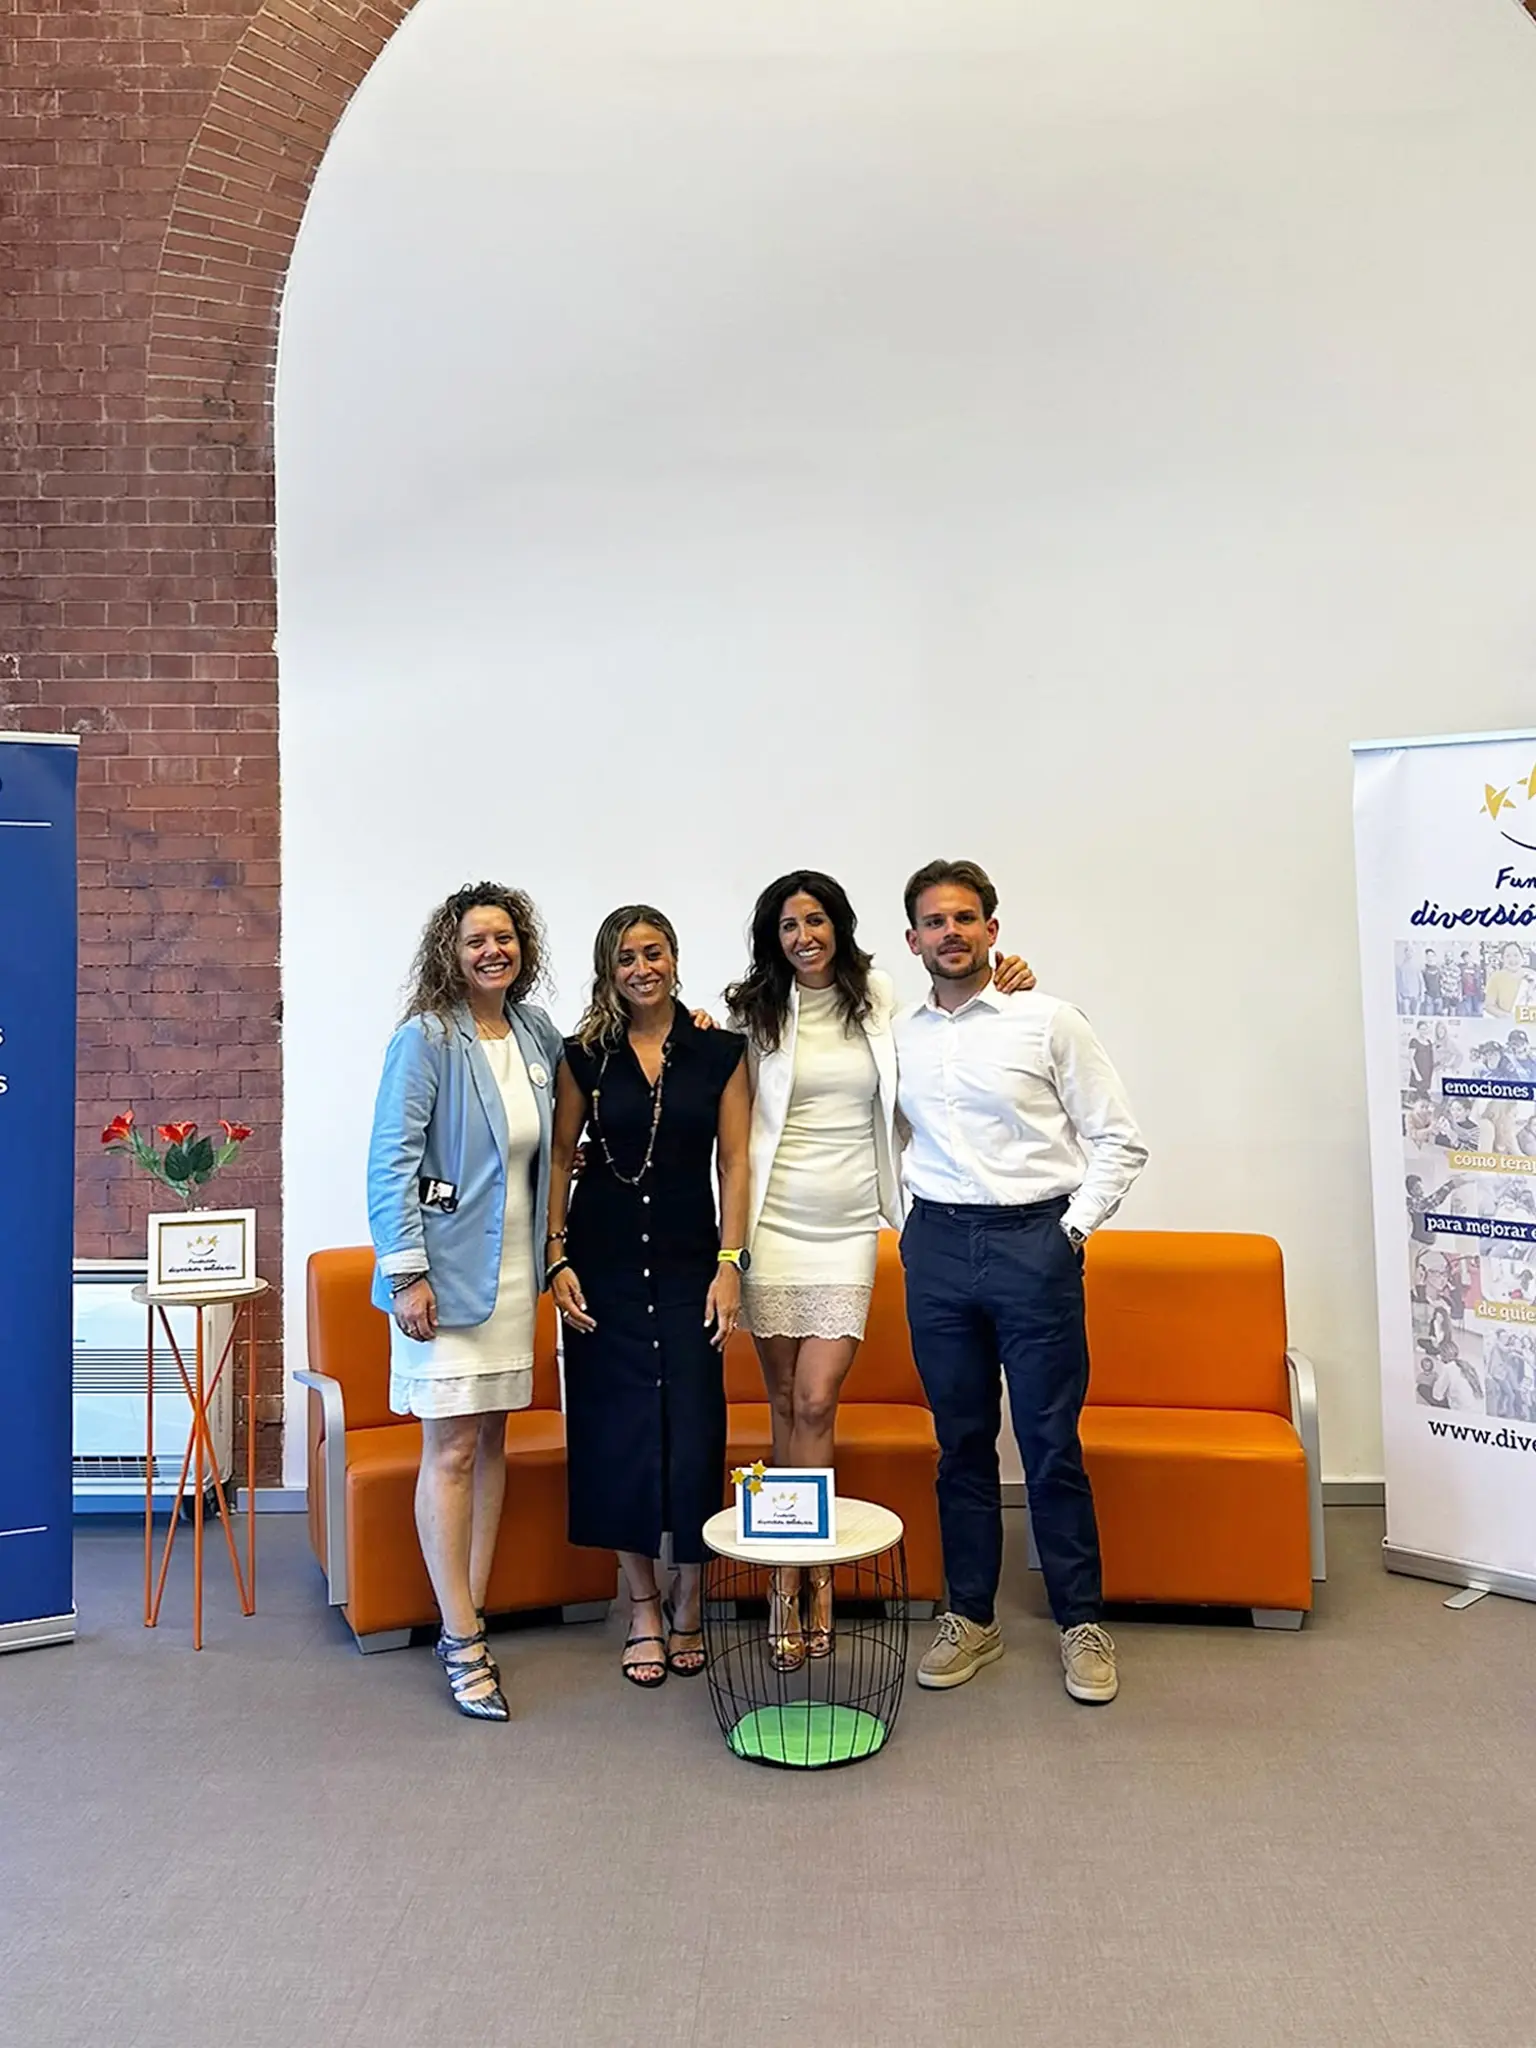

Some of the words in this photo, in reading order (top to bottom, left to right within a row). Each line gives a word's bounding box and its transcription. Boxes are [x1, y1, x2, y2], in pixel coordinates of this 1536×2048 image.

[1445, 1081, 1529, 1098] emociones
[1454, 1154, 1497, 1169] como
[1427, 1217, 1463, 1232] para
[1466, 1220, 1528, 1238] mejorar
[1478, 1300, 1497, 1317] de
